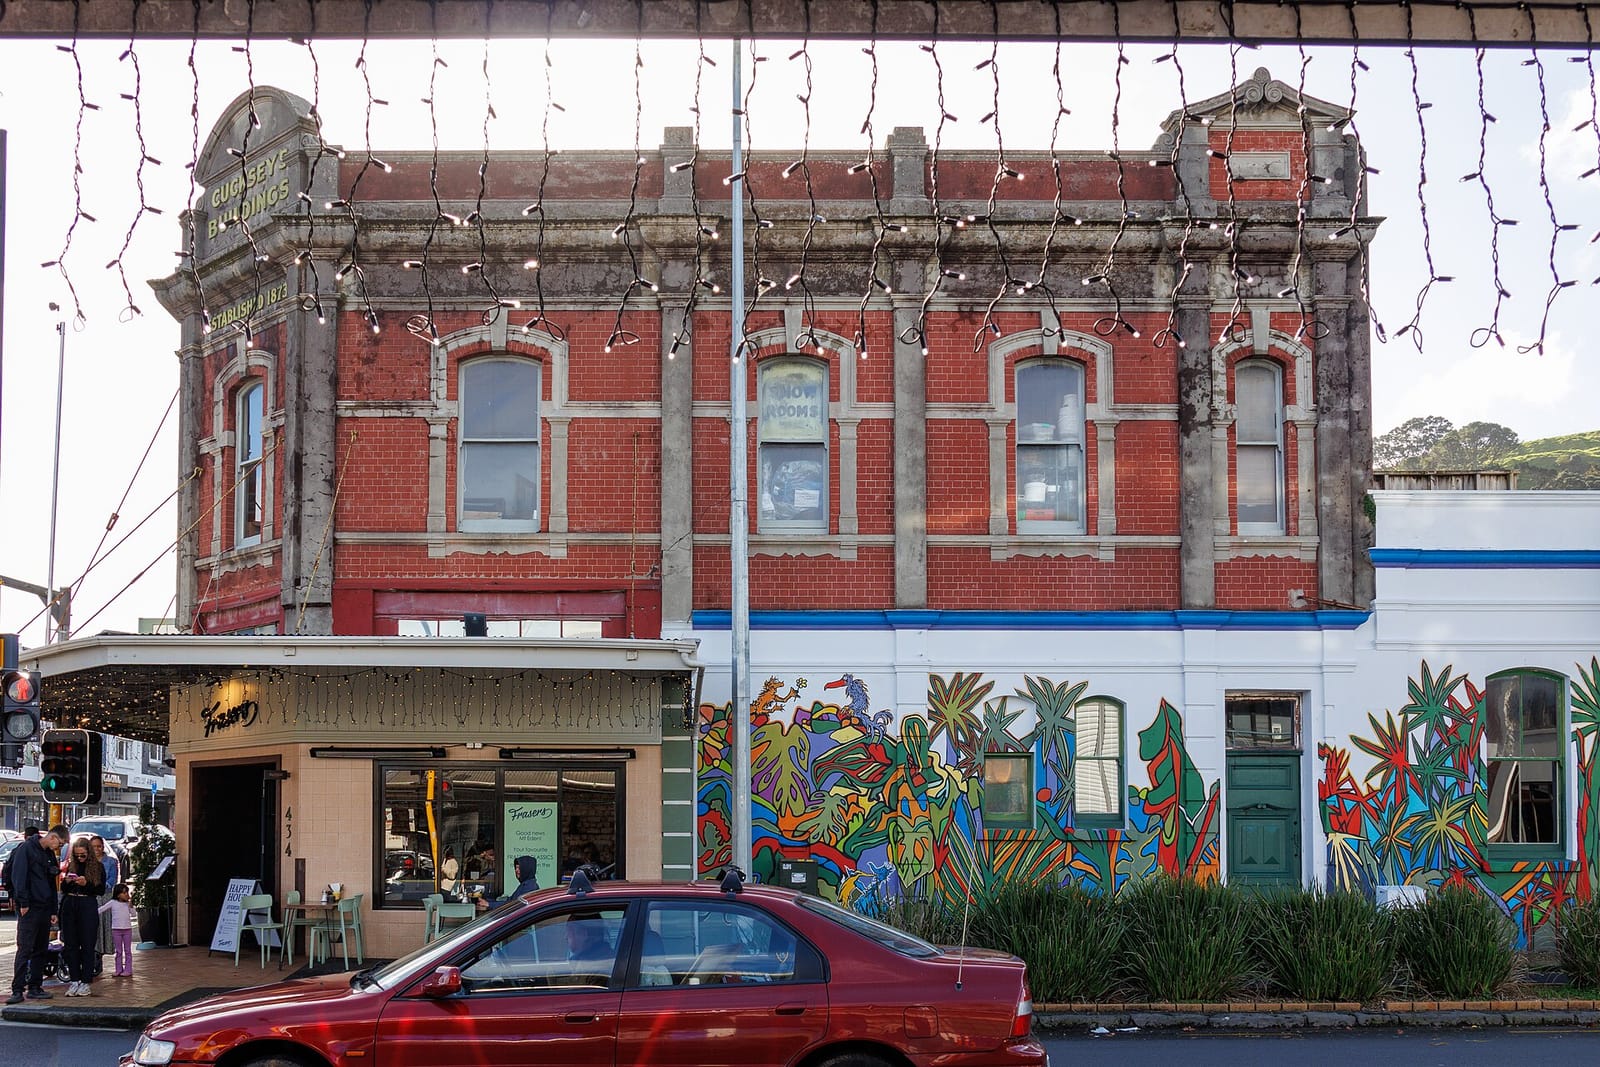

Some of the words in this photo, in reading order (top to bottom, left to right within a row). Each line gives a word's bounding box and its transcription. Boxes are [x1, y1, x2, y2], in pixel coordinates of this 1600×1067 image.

[209, 295, 264, 332] STABLISH'D
[267, 282, 288, 306] 1873
[767, 405, 818, 418] ROOMS
[508, 806, 553, 821] Frasers
[229, 883, 252, 894] HAPPY
